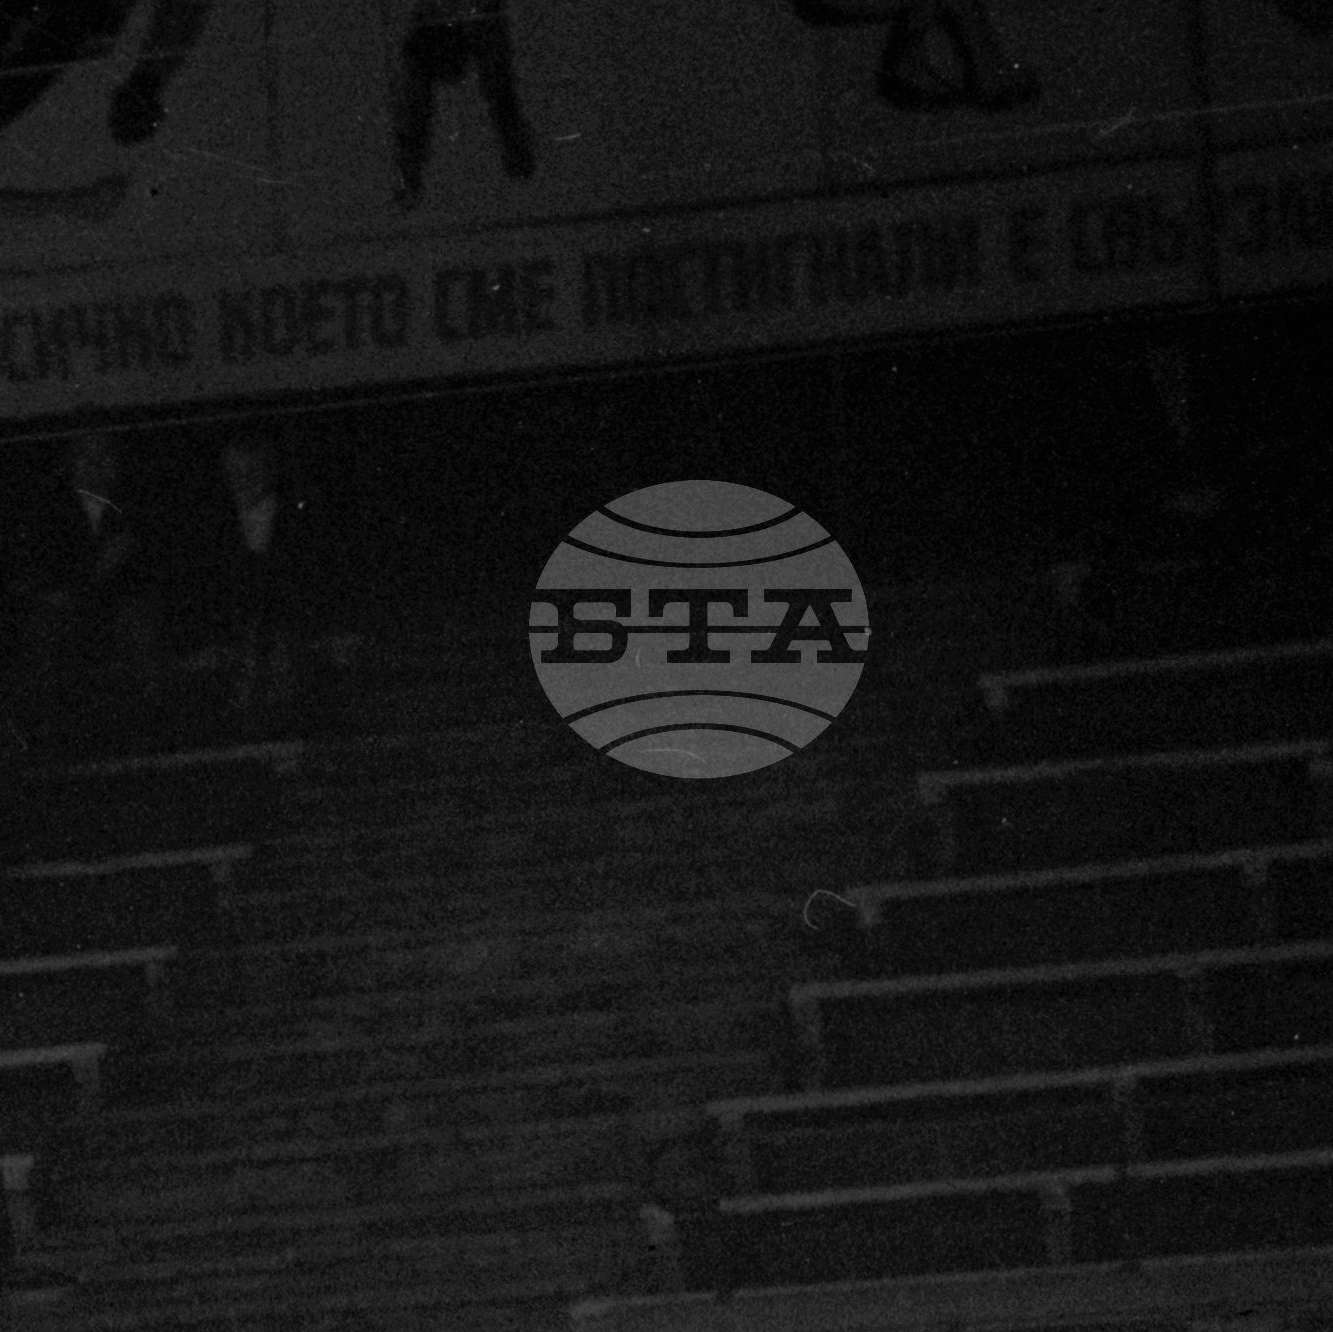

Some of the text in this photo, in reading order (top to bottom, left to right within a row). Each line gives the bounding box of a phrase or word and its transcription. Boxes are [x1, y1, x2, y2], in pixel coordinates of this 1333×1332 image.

[217, 270, 408, 364] КОЕТО
[434, 255, 555, 341] СМЕ
[582, 215, 981, 327] ПОСТИГНАЛИ
[1007, 205, 1046, 283] Е
